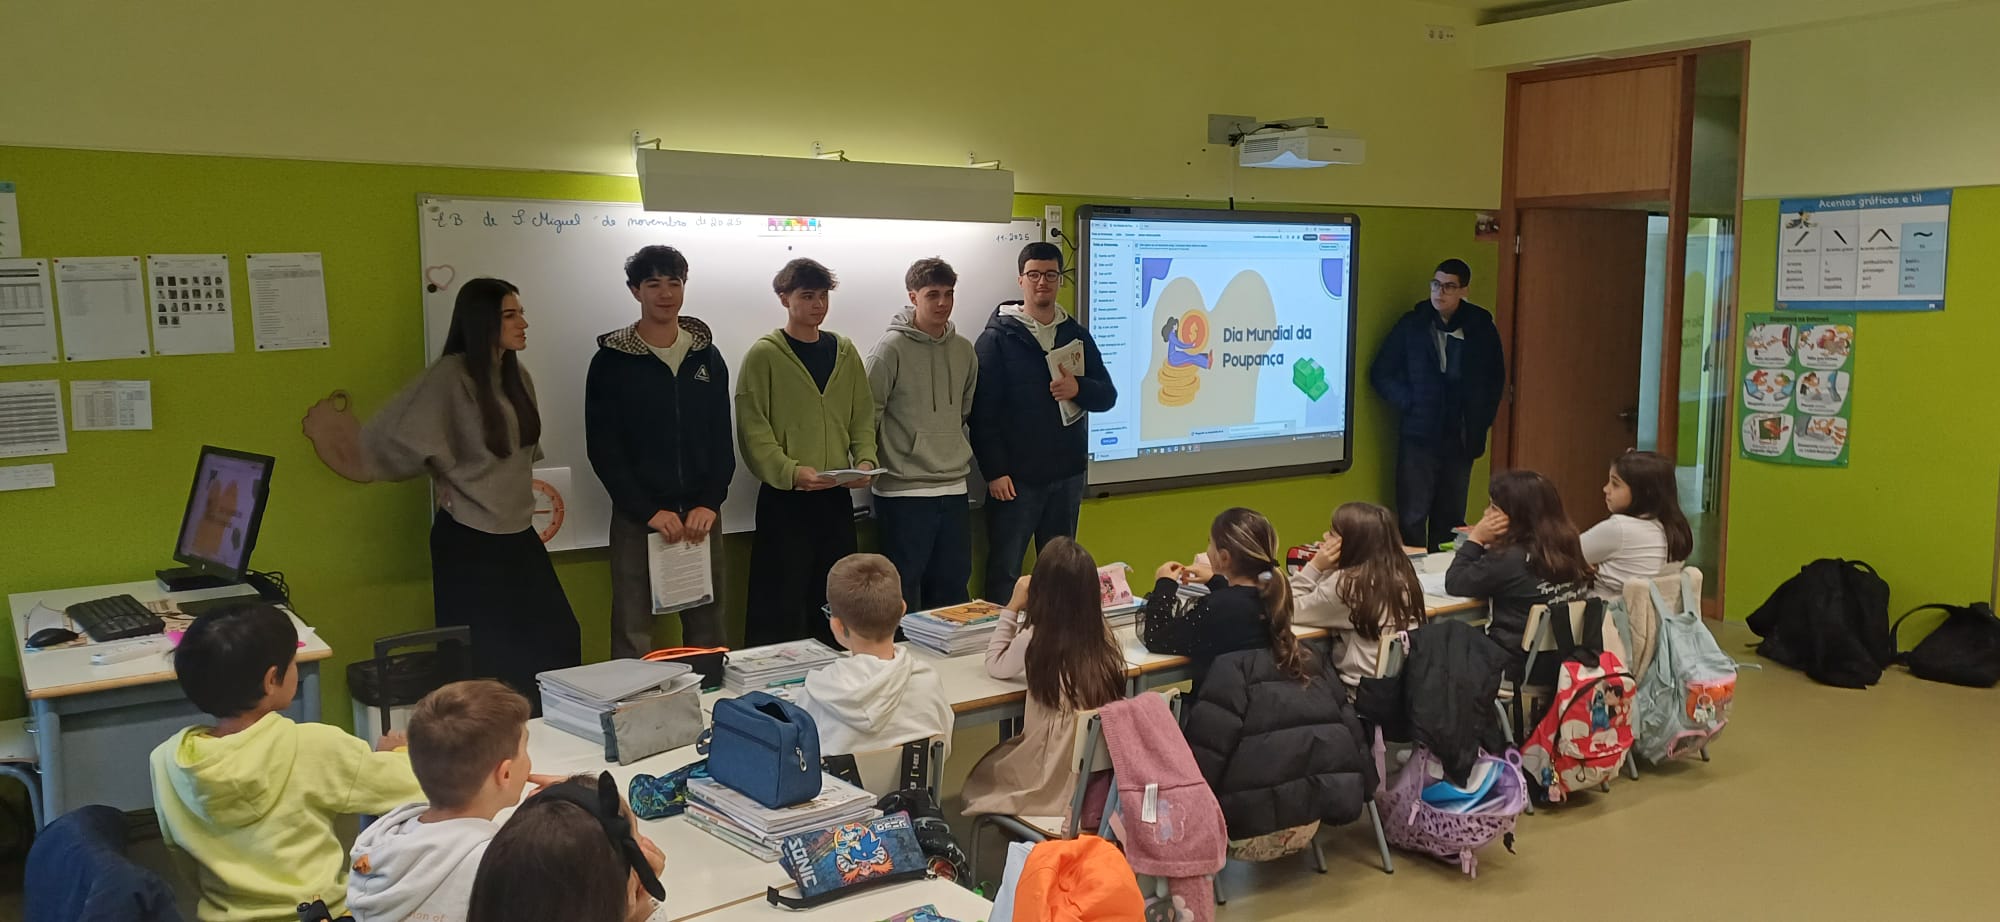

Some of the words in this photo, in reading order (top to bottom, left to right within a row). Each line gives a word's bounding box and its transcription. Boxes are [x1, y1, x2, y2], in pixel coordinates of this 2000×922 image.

[1818, 198, 1856, 209] Acentos
[1858, 196, 1899, 209] gráficos
[1911, 193, 1922, 203] til
[483, 210, 498, 227] de
[532, 211, 581, 234] Miguel
[1223, 326, 1243, 342] Dia
[1246, 324, 1293, 342] Mundial
[1296, 324, 1312, 340] da
[1222, 352, 1284, 370] Poupança
[788, 837, 818, 889] SONIC
